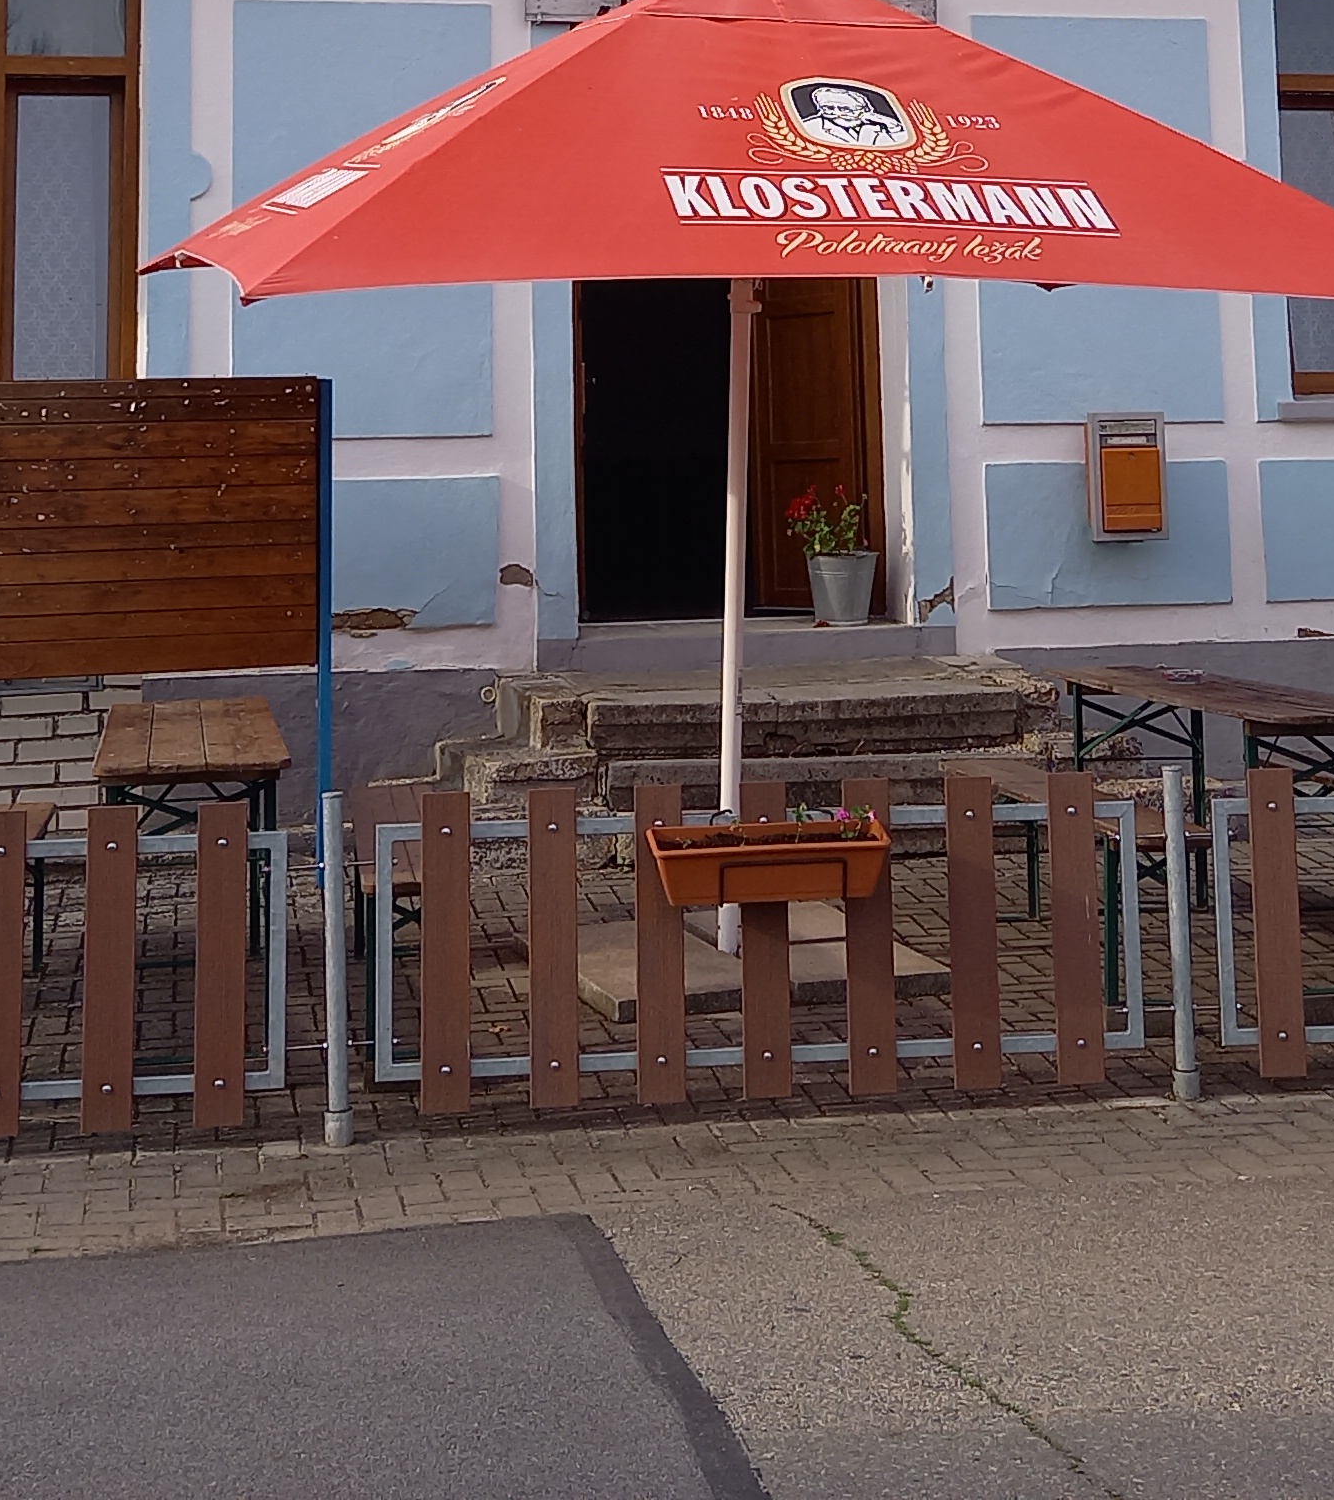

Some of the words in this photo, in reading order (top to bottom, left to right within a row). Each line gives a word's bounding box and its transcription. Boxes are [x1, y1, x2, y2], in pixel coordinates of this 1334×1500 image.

[697, 105, 754, 120] 1848
[945, 114, 1001, 130] 1923
[664, 173, 1116, 231] KLOSTERMANN
[776, 229, 958, 263] Polotmavý
[963, 234, 1043, 264] ležák
